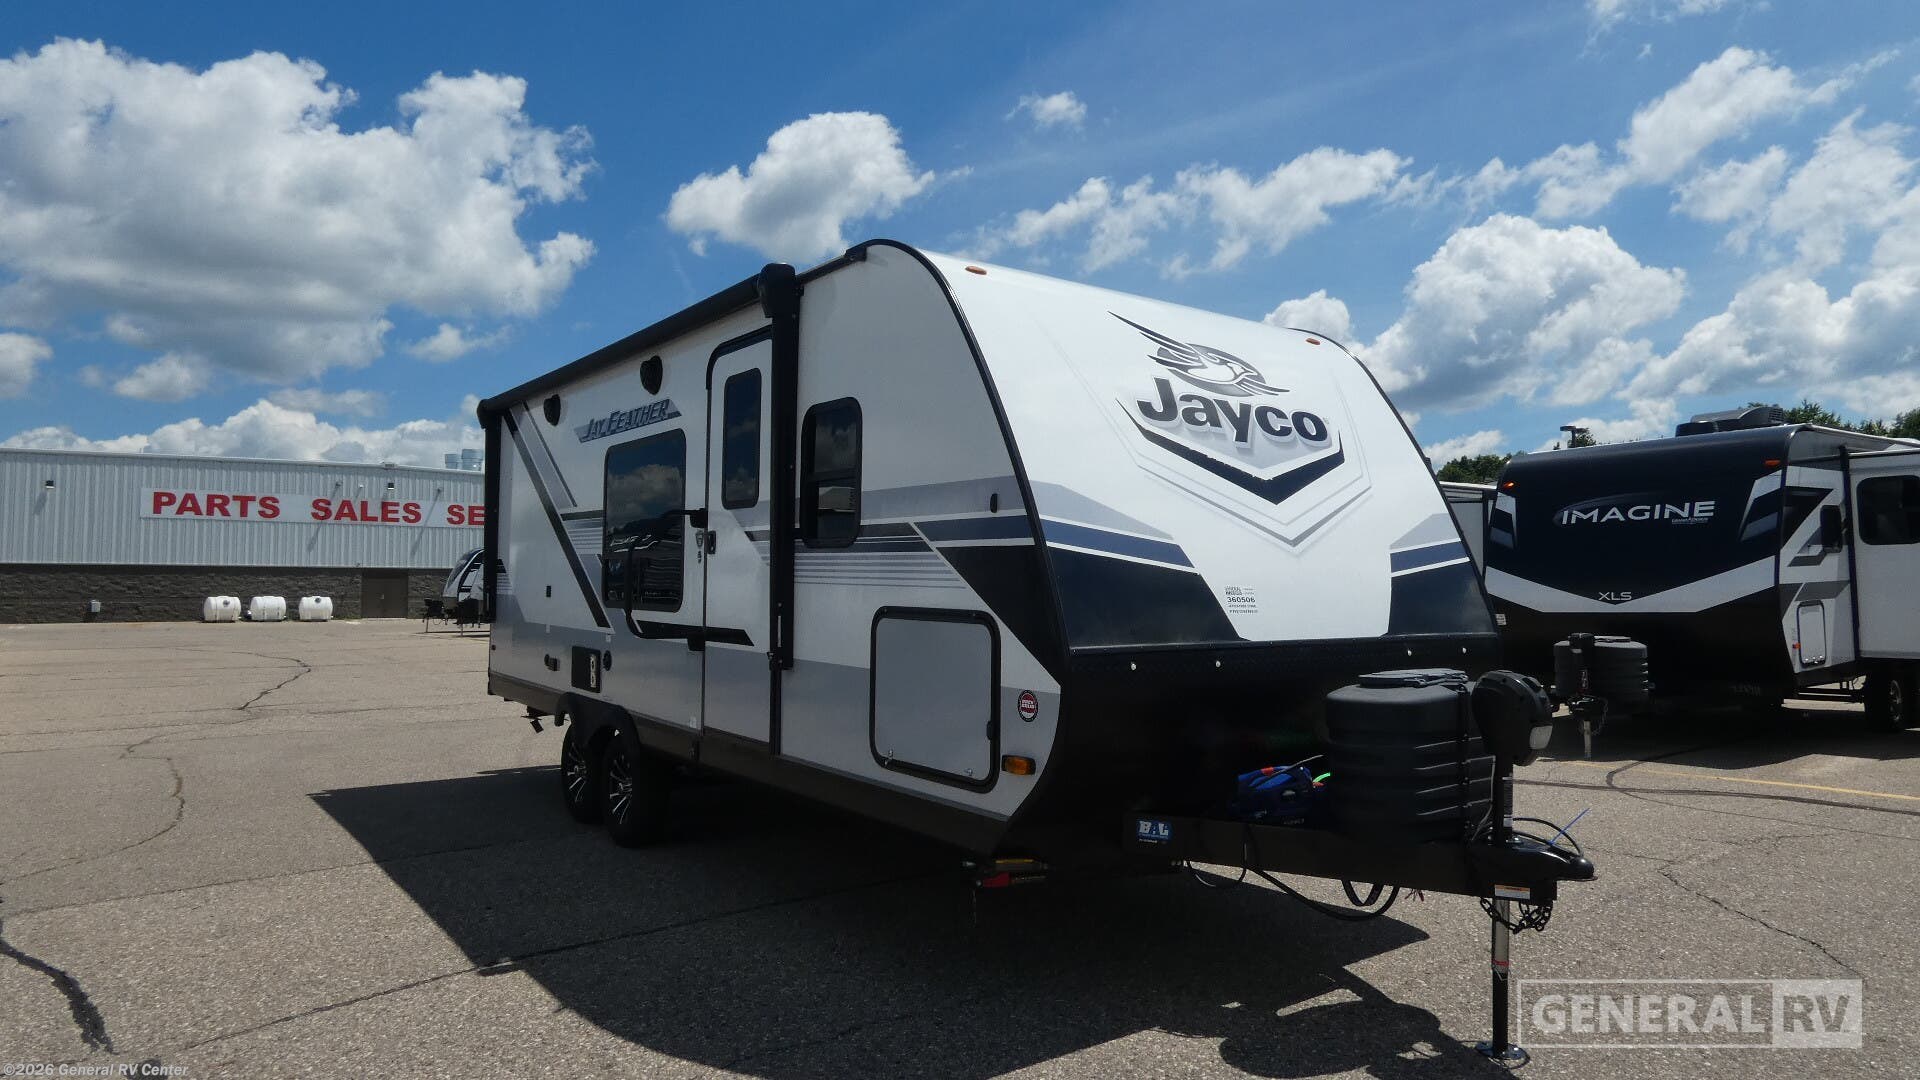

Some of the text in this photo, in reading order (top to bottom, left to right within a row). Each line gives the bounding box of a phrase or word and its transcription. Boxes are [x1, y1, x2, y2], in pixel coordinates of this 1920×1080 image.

[1136, 377, 1330, 443] Jayco
[152, 491, 281, 519] PARTS
[310, 498, 422, 524] SALES
[1561, 500, 1716, 525] IMAGINE
[1598, 591, 1632, 601] XLS
